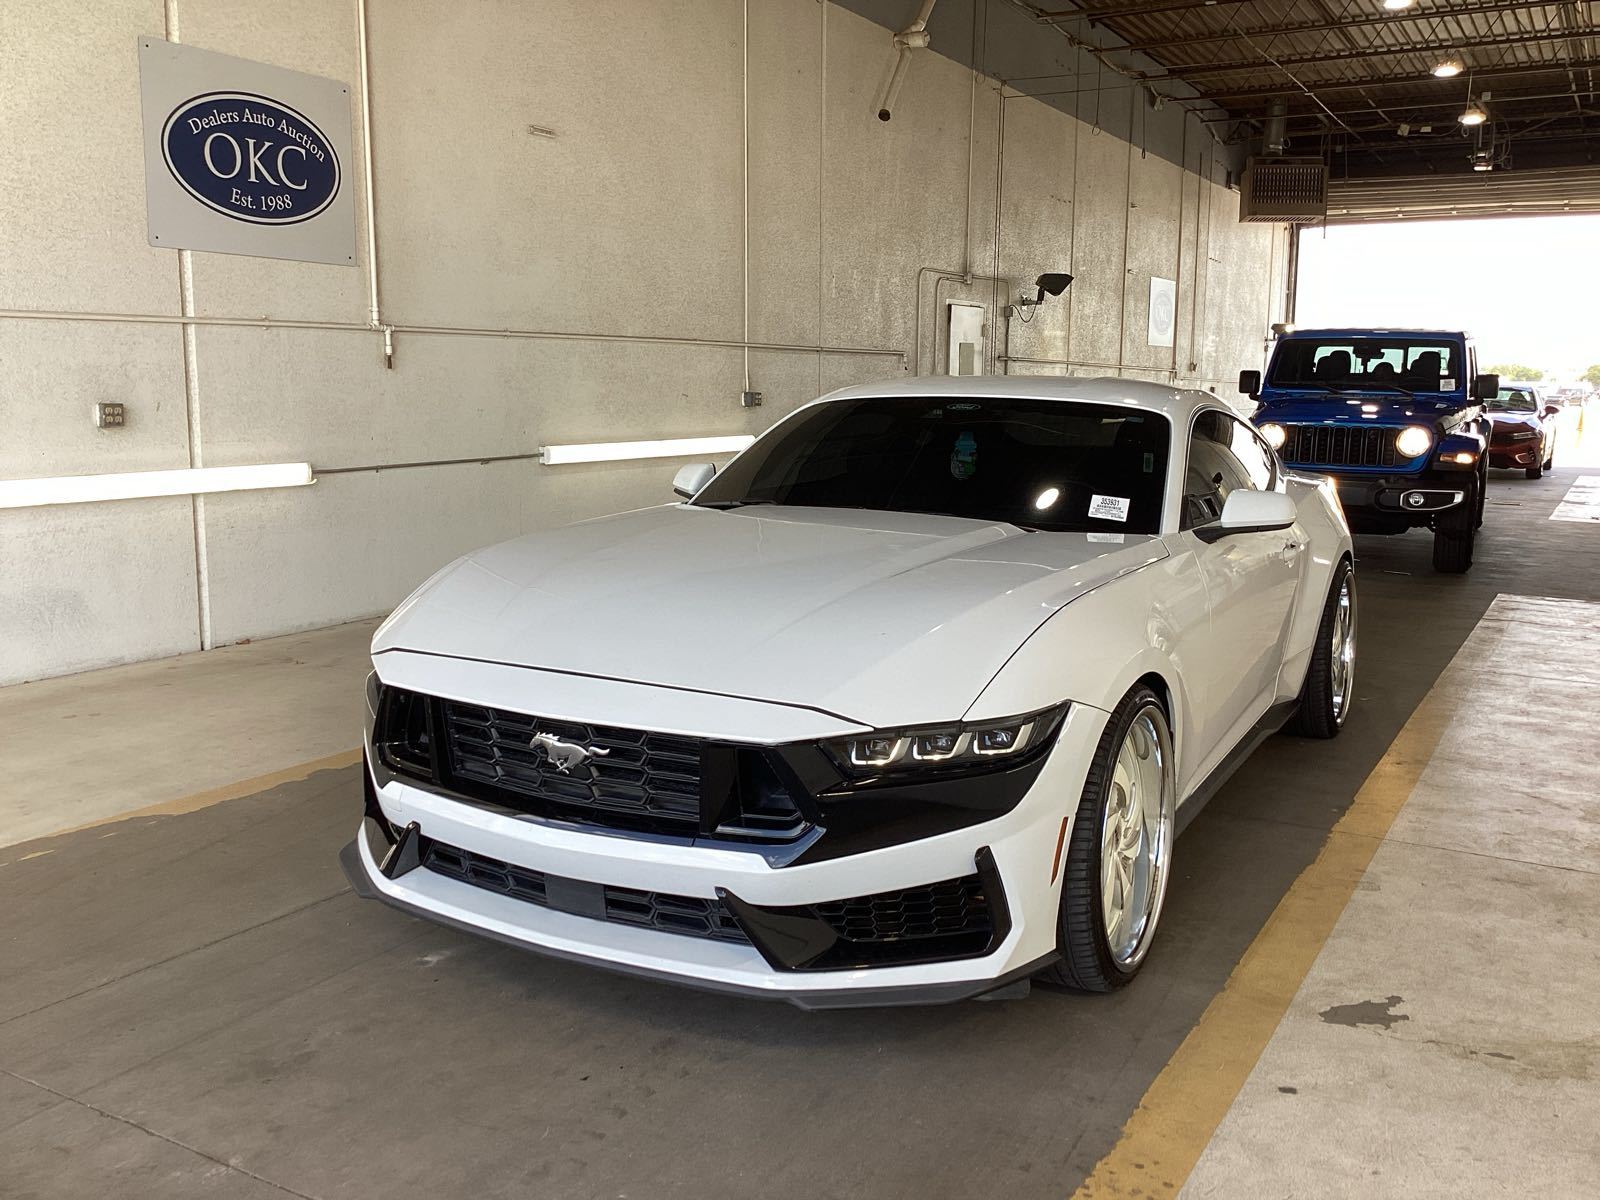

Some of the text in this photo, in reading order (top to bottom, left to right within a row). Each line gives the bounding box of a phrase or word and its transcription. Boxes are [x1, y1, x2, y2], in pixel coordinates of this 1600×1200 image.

[187, 108, 325, 163] Dealers Auto Auction
[204, 132, 308, 190] OKC
[230, 187, 292, 212] Est. 1988
